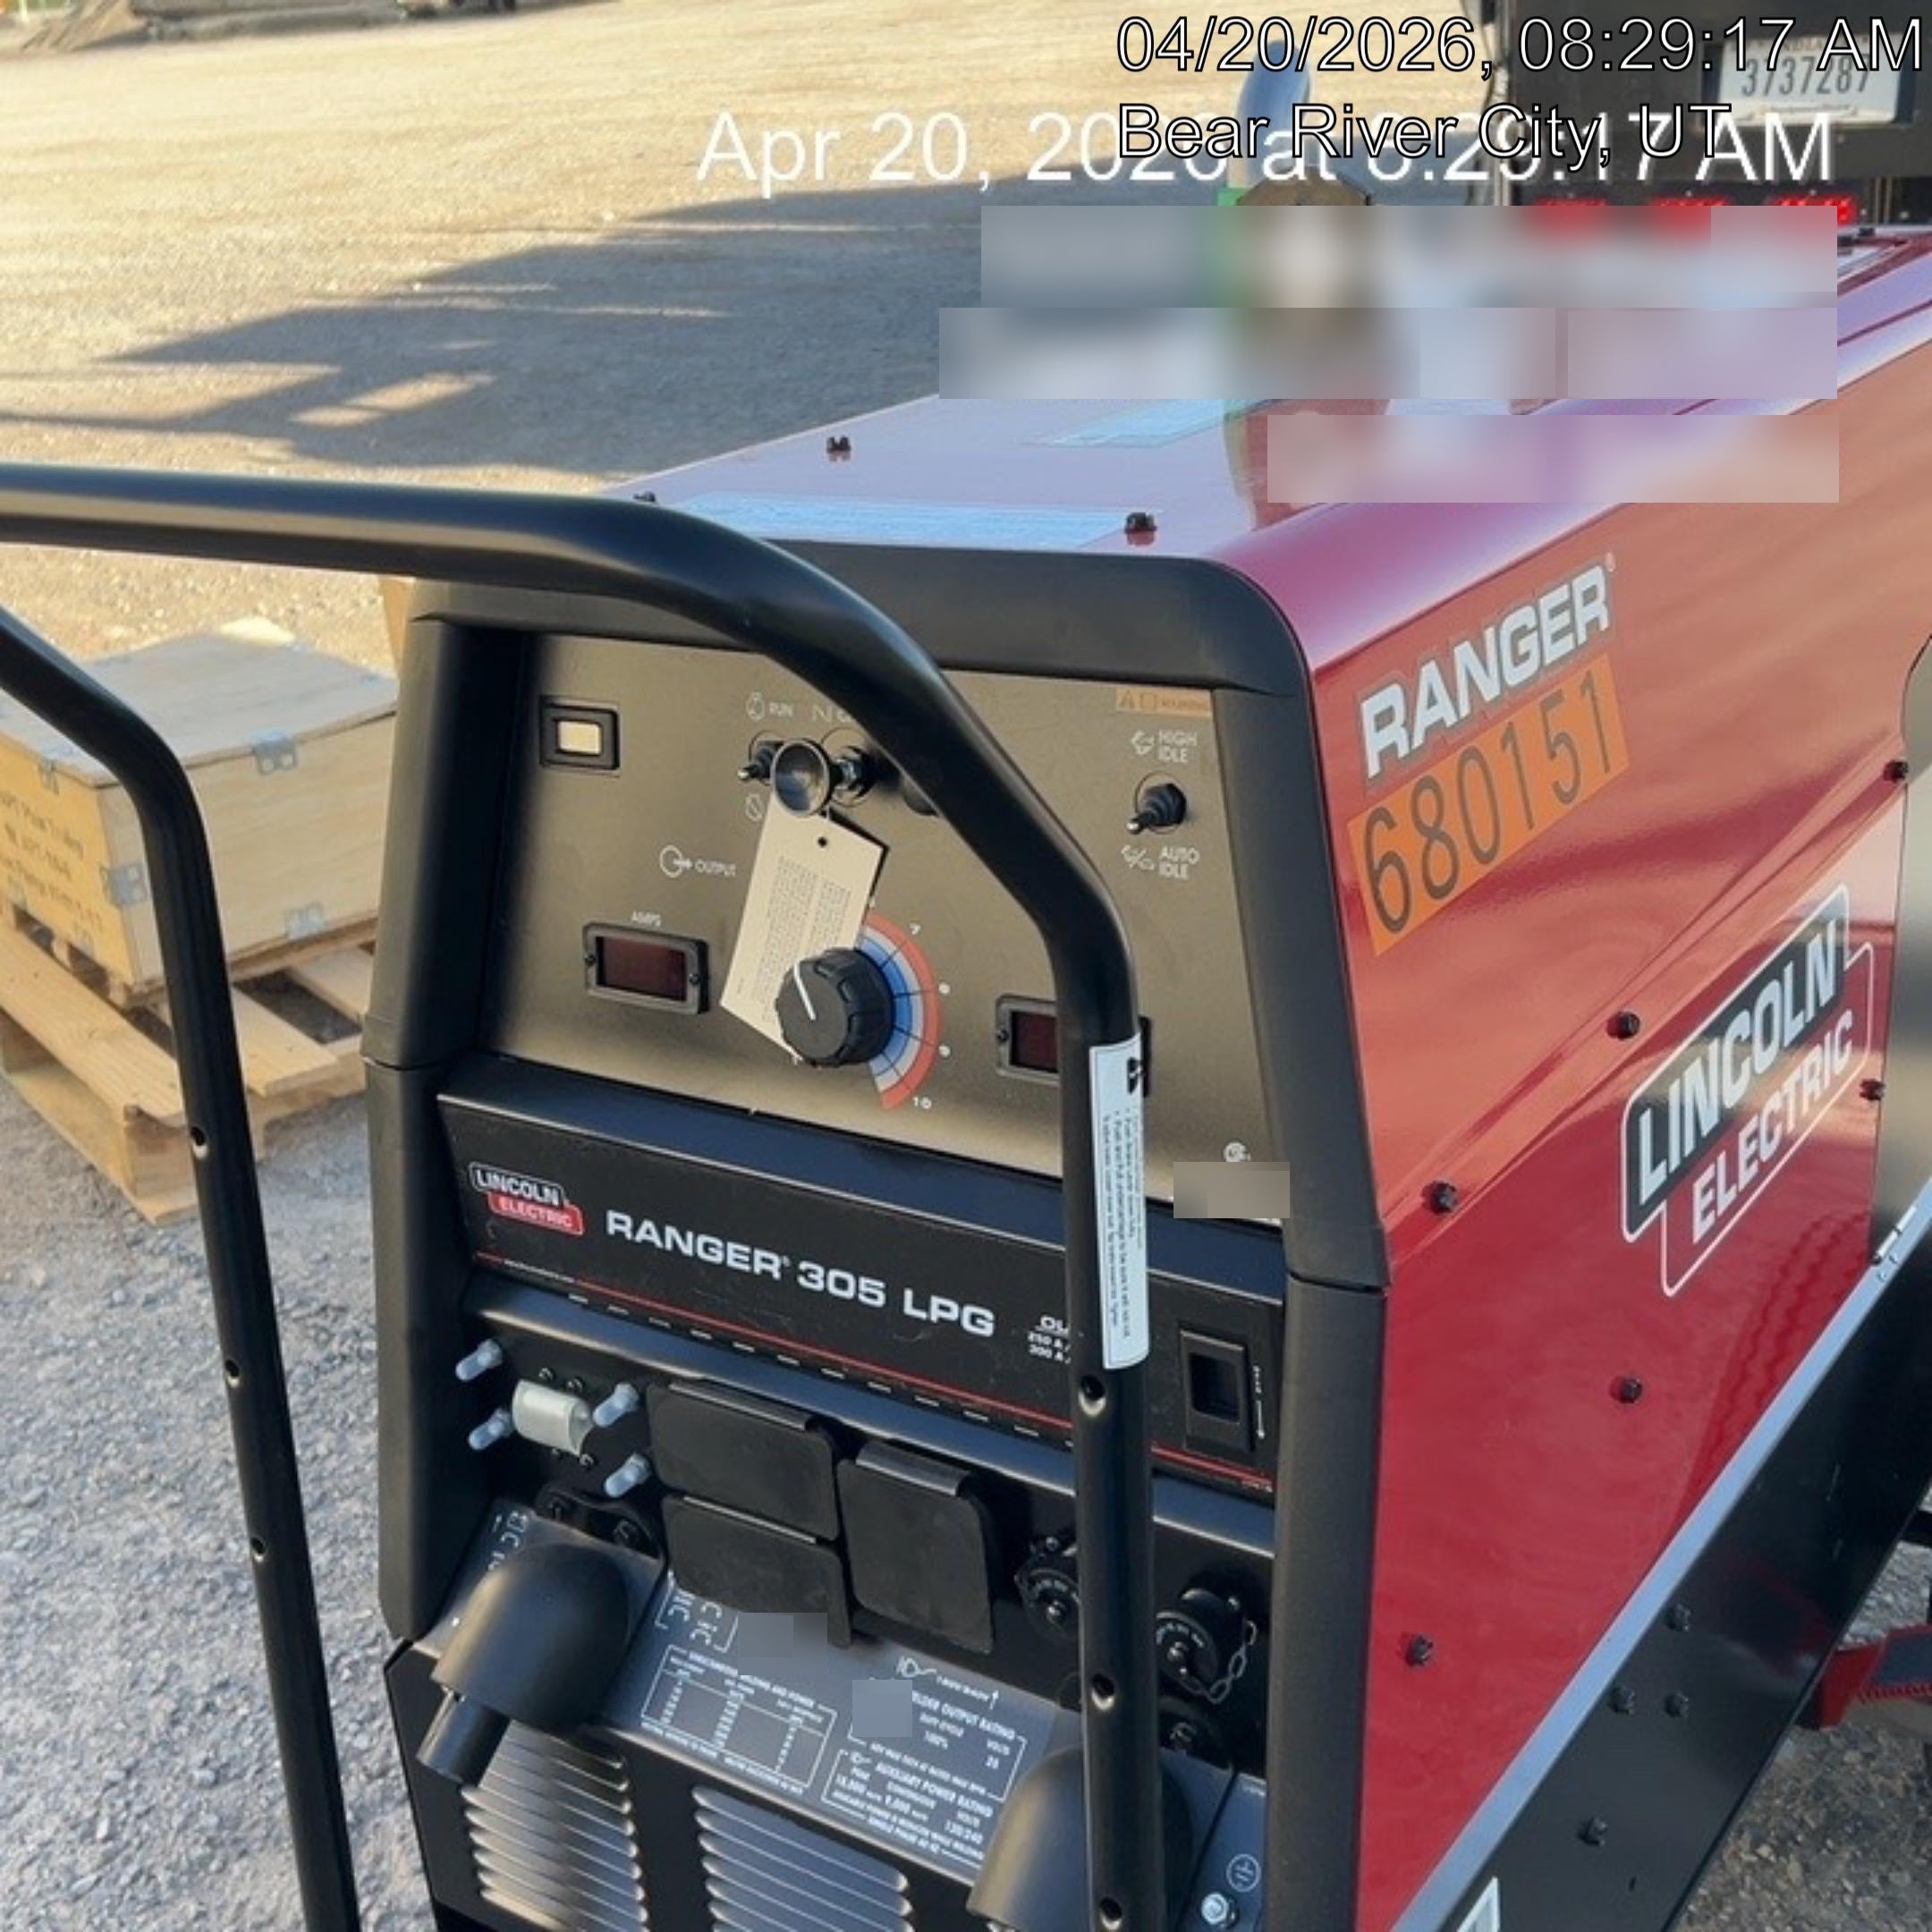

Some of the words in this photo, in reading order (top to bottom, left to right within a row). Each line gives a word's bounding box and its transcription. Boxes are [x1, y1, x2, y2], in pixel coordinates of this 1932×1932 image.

[1360, 564, 1610, 780] RANGER
[1159, 846, 1199, 865] AUTO
[1363, 669, 1612, 935] 680151
[1638, 918, 1837, 1206] LINCOLN
[1692, 1009, 1854, 1245] ELECTRIC
[475, 1168, 560, 1207] LINCOLN
[498, 1196, 574, 1229] ELECTRIC
[606, 1209, 783, 1281] RANGER
[796, 1261, 886, 1308] 305
[902, 1287, 996, 1337] LPG
